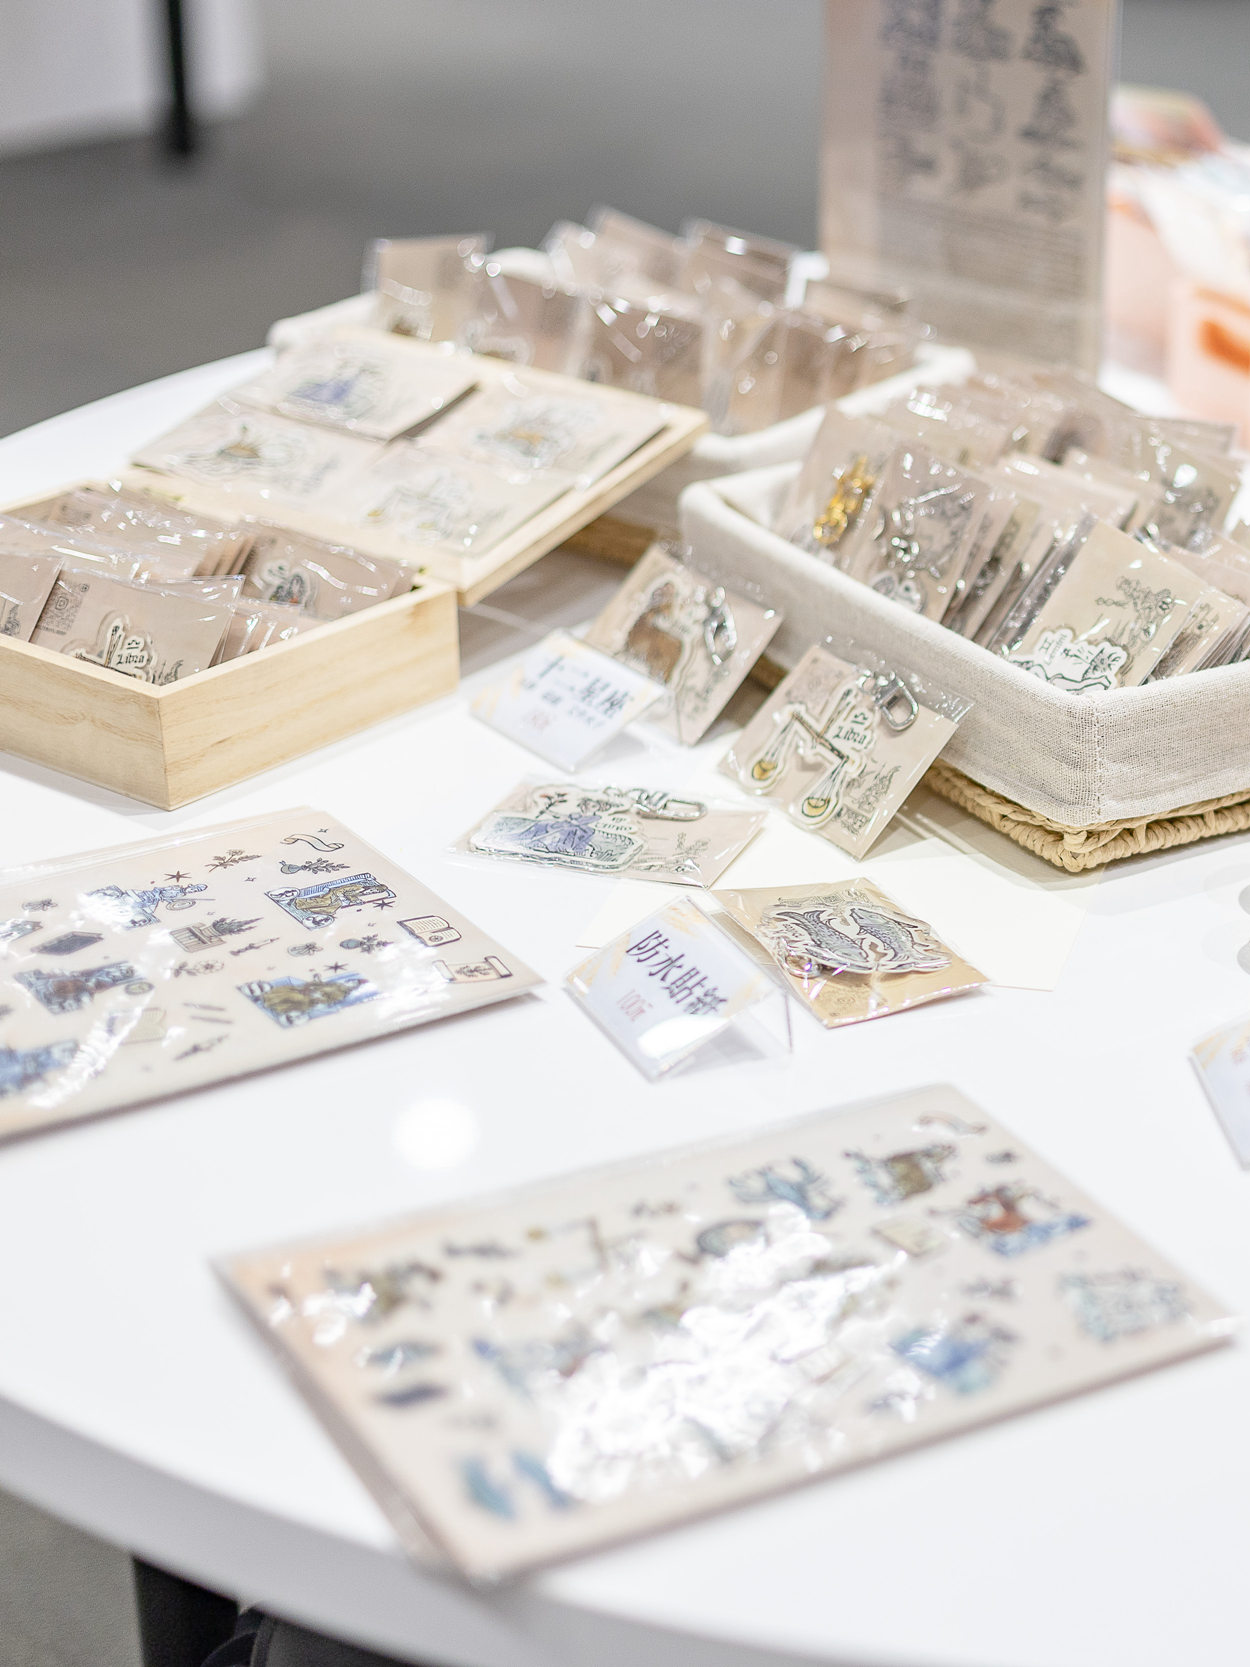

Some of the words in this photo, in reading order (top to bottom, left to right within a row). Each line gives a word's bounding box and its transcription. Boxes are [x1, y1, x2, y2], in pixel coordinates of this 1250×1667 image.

[116, 652, 145, 666] Libra
[832, 725, 868, 745] Libra
[626, 930, 728, 1015] 防水貼紙
